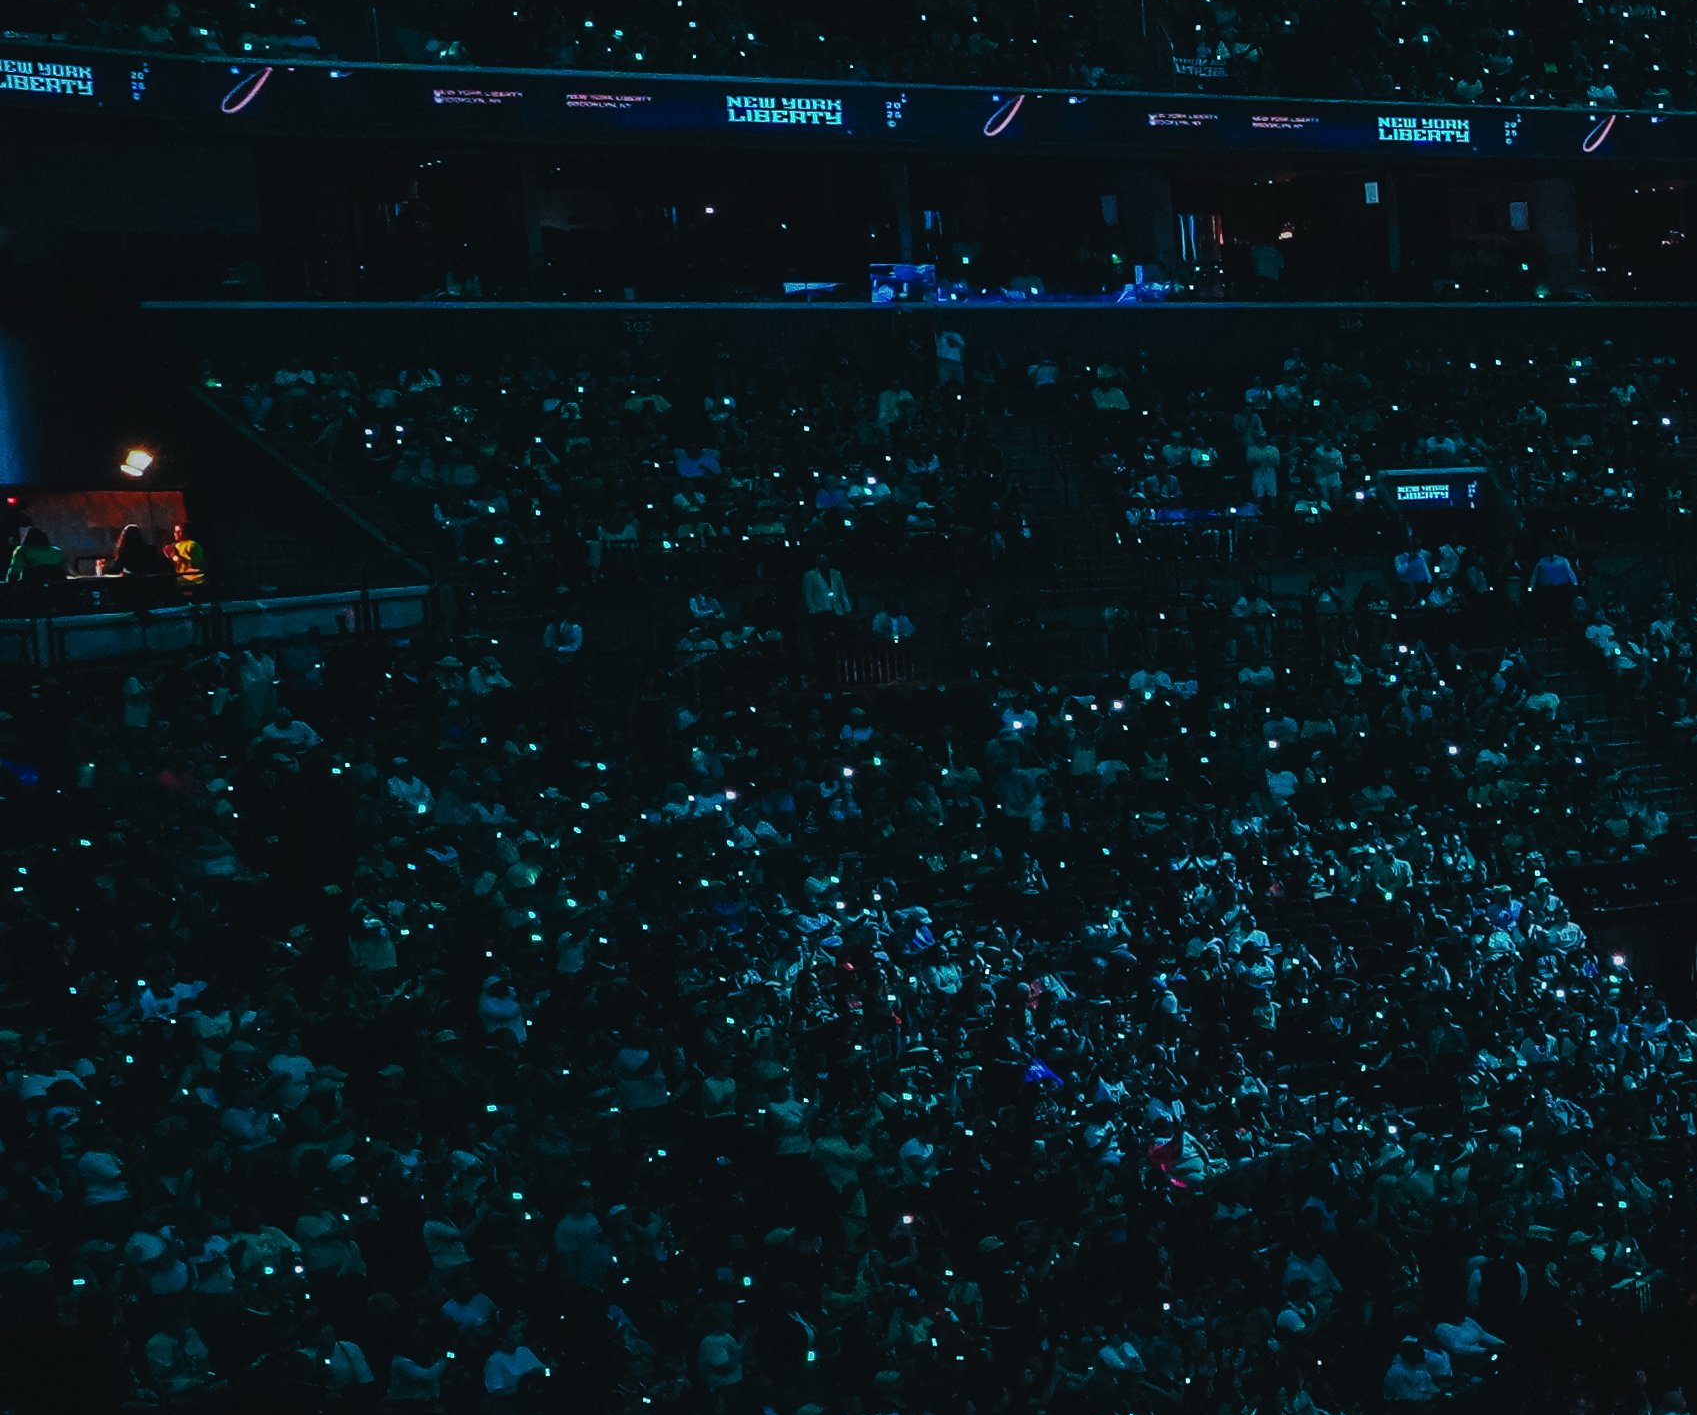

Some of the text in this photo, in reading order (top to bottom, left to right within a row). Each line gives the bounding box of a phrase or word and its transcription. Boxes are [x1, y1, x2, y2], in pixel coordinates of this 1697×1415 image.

[38, 61, 93, 79] YORK
[726, 95, 842, 111] NEW YORK
[726, 108, 843, 125] LIBERTY
[1378, 117, 1470, 131] NEW YORK
[1378, 129, 1470, 142] LIBERTY
